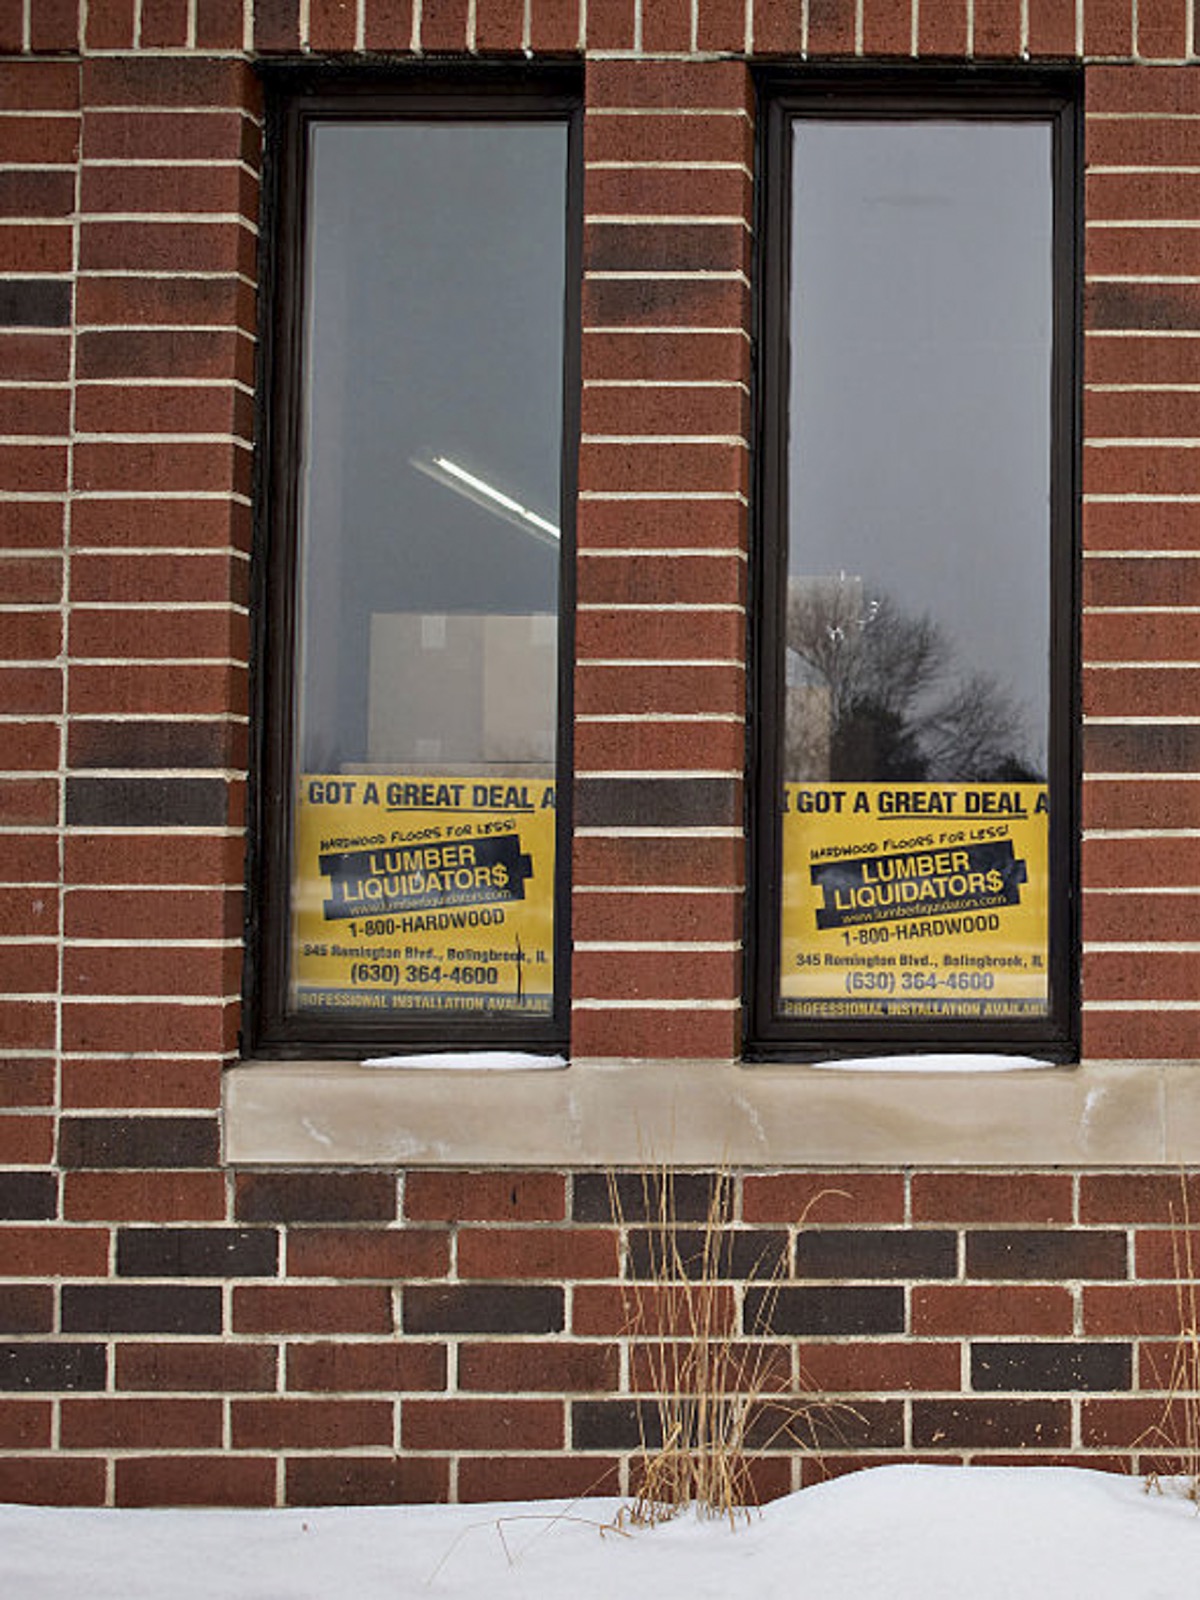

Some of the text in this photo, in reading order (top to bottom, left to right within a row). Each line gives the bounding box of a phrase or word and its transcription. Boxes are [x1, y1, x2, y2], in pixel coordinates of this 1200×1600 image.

[309, 781, 356, 805] GOT
[363, 783, 379, 805] A
[386, 783, 464, 806] GREAT
[473, 786, 534, 808] DEAL
[796, 791, 846, 813] GOT
[853, 791, 870, 813] A
[877, 791, 958, 813] GREAT
[965, 791, 1027, 813] DEAL
[321, 834, 386, 850] HARDWOOD
[391, 830, 441, 843] FLOORS
[447, 824, 472, 836] FOR
[810, 843, 877, 860] HARDWOOD
[883, 835, 934, 851] FLOORS
[939, 832, 964, 843] FOR
[370, 845, 476, 875] LUMBER
[862, 852, 969, 884] LUMBER
[348, 909, 504, 937] 1-800-HARDWOOD
[842, 915, 1000, 946] 1-800-HARDWOOD
[304, 944, 327, 956] 345
[796, 954, 820, 967] 345
[351, 965, 498, 986] (630) 364-4600
[846, 972, 994, 993] (630) 364-4600
[393, 995, 484, 1010] INSTALLATION
[888, 1001, 979, 1016] INSTALLATION
